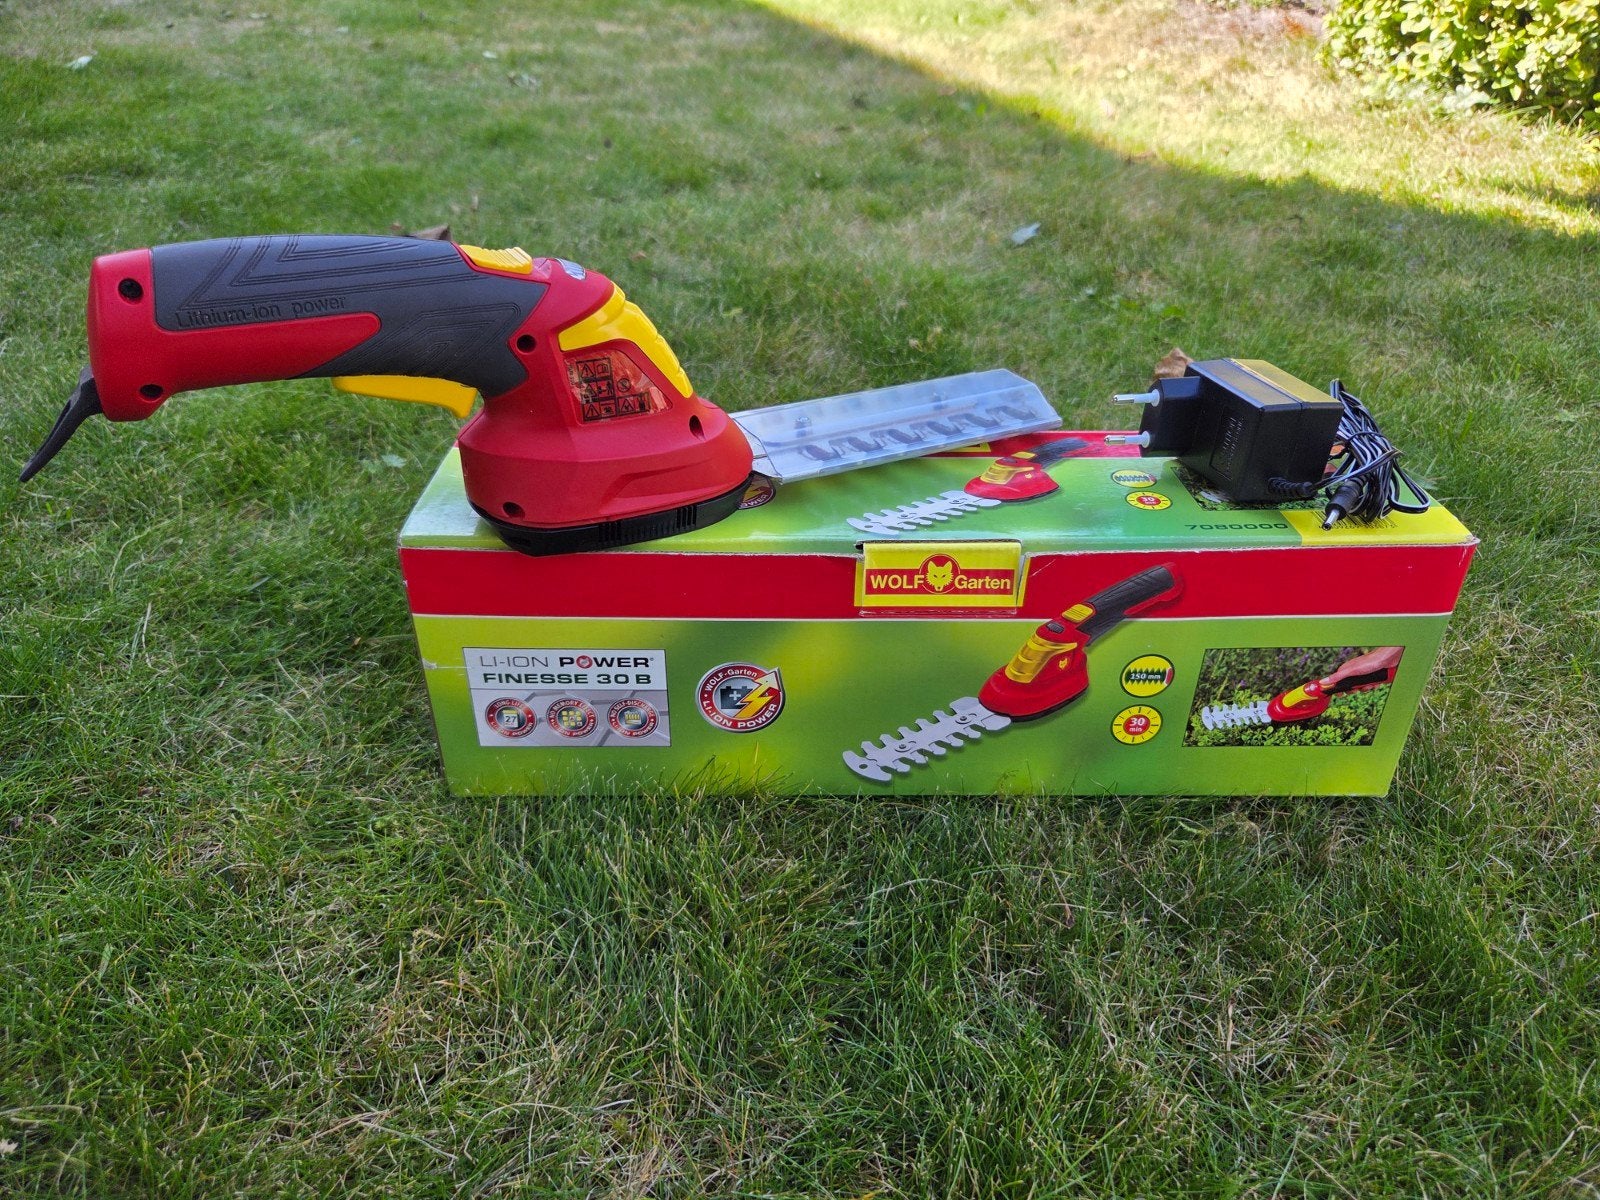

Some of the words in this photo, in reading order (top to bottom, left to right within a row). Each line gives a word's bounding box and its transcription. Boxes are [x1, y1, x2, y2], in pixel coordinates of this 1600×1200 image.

[174, 303, 281, 328] Lithium-ion
[292, 297, 346, 317] power
[870, 575, 925, 589] WOLF
[954, 575, 1011, 589] Garten
[480, 655, 549, 667] LI-ION
[483, 673, 589, 684] FINESSE
[597, 673, 629, 684] 30
[635, 674, 652, 684] B
[504, 715, 517, 723] 27
[737, 703, 777, 728] POWER
[1129, 717, 1146, 726] 30
